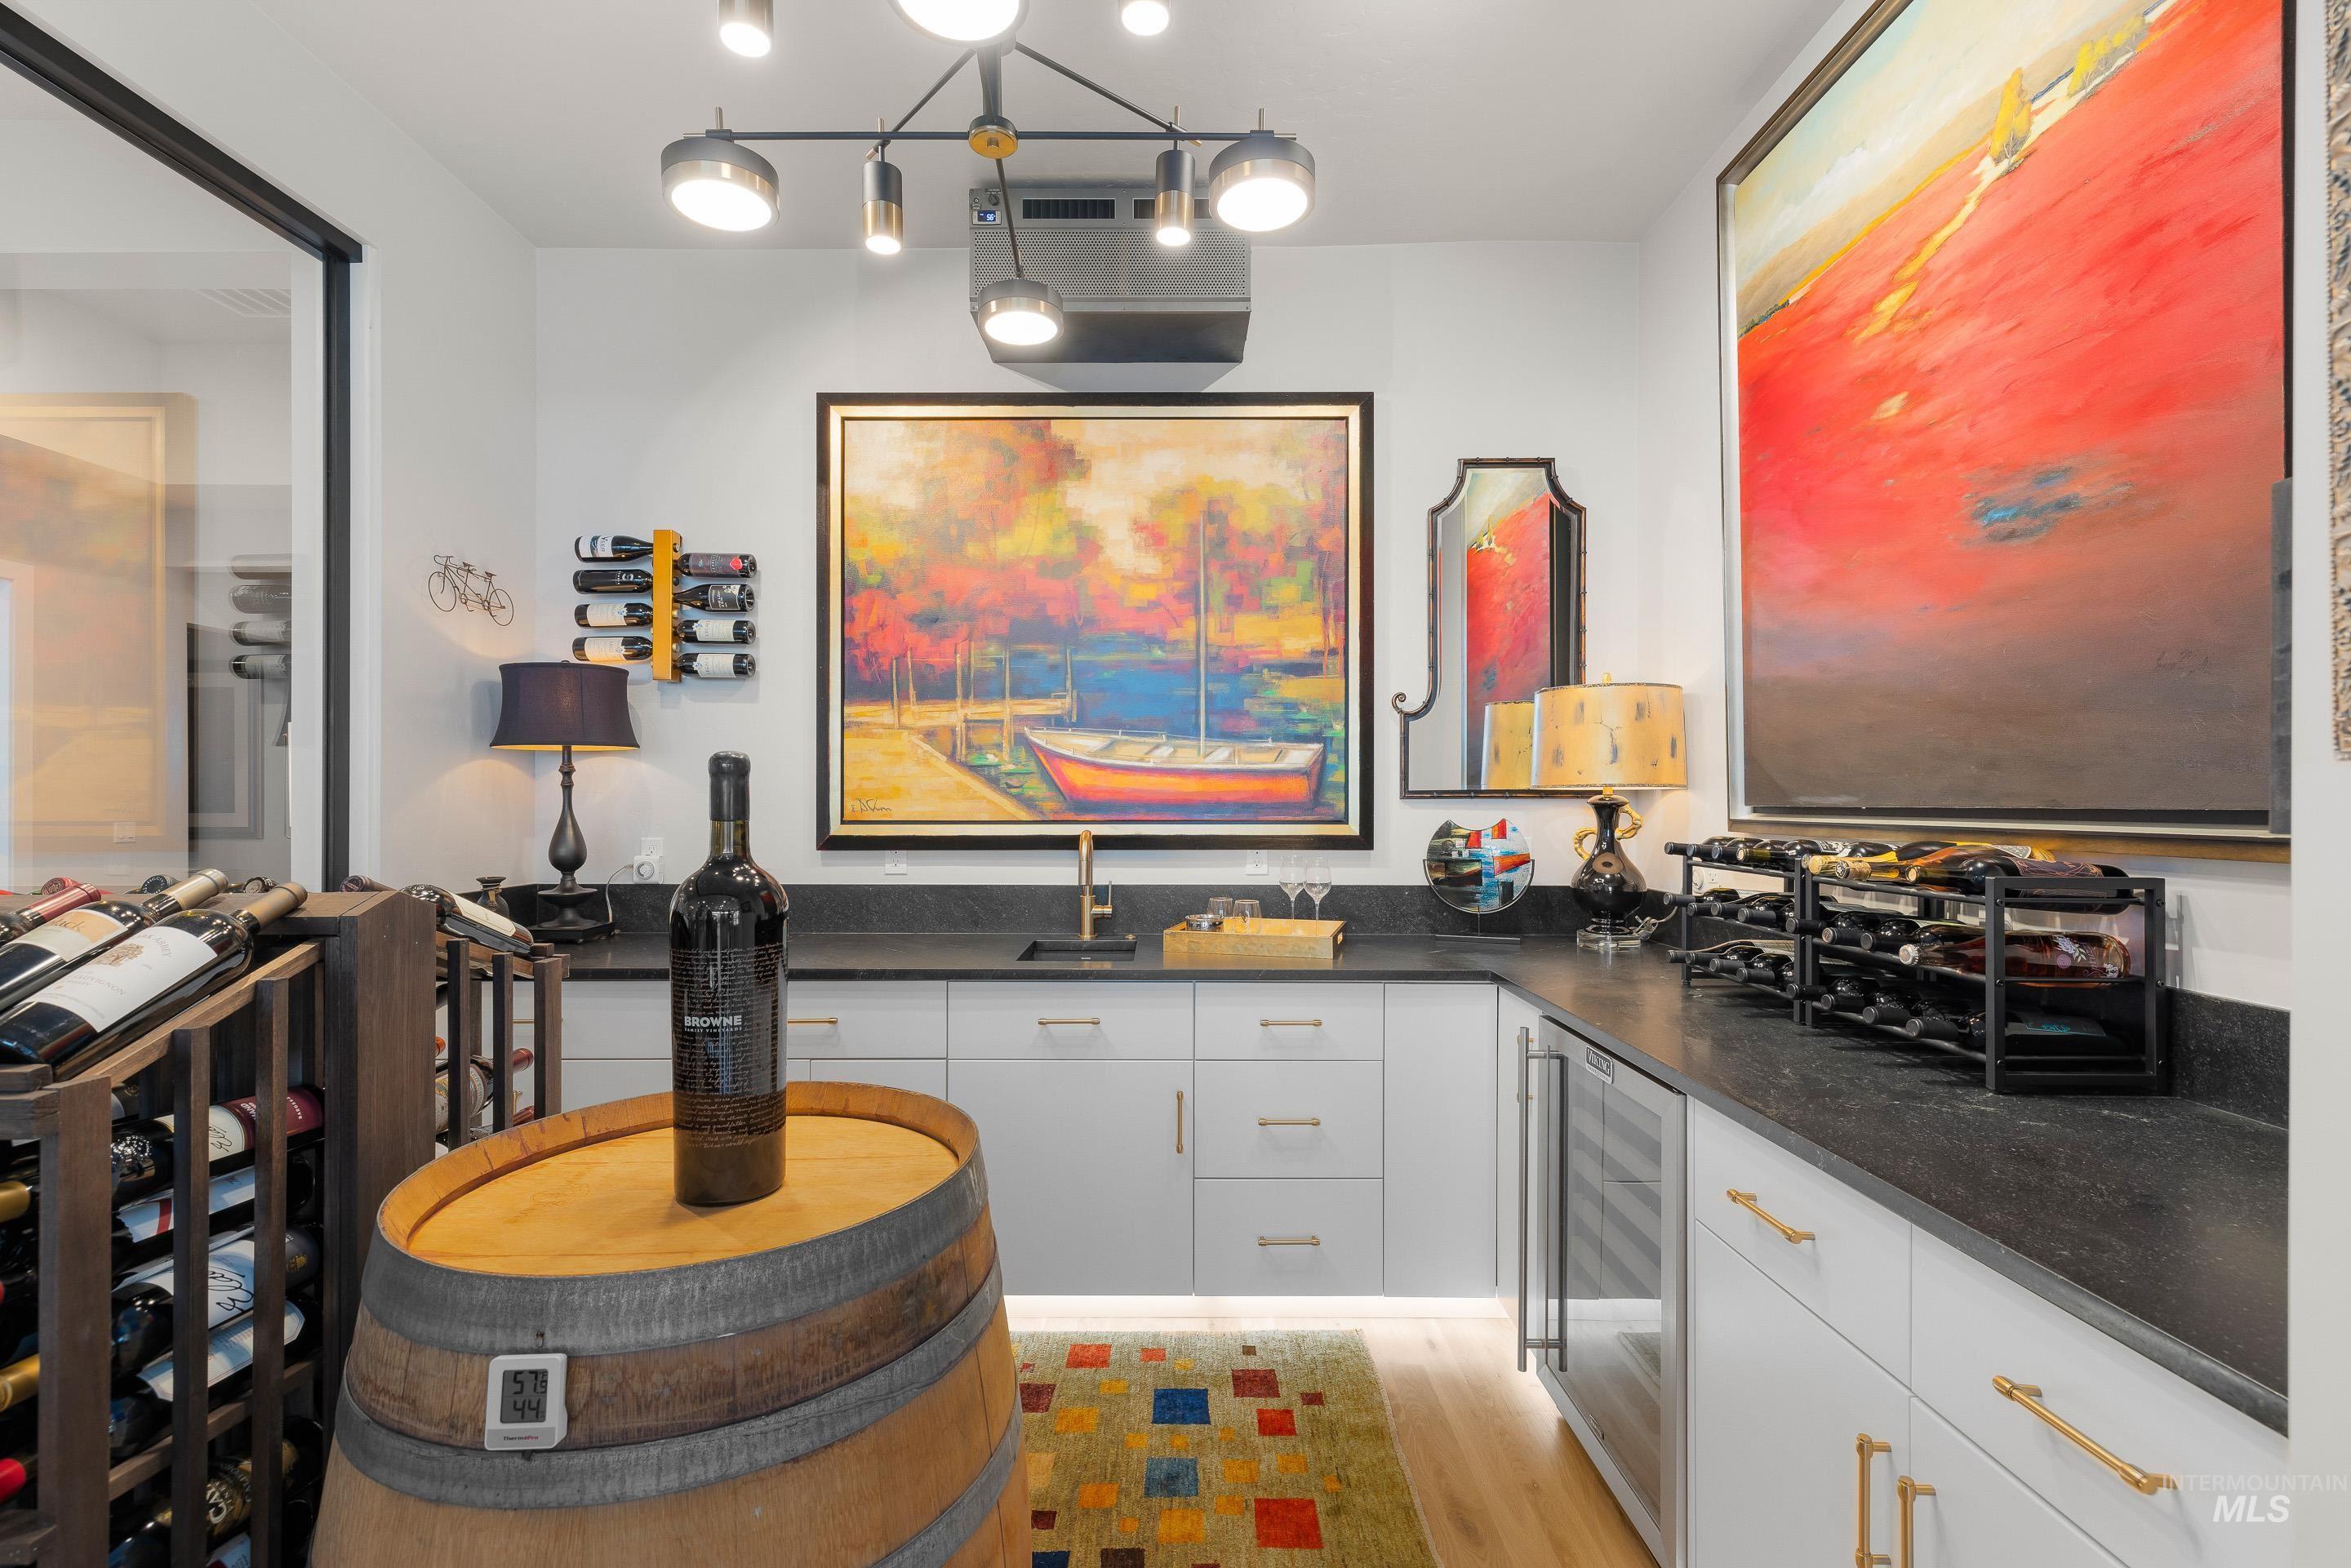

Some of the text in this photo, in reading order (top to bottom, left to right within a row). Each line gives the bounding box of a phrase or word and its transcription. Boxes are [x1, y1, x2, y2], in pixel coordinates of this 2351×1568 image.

[154, 936, 173, 961] ABBEY
[683, 1015, 743, 1028] BROWNE
[1587, 1048, 1611, 1076] VIKING
[513, 1398, 541, 1420] 44
